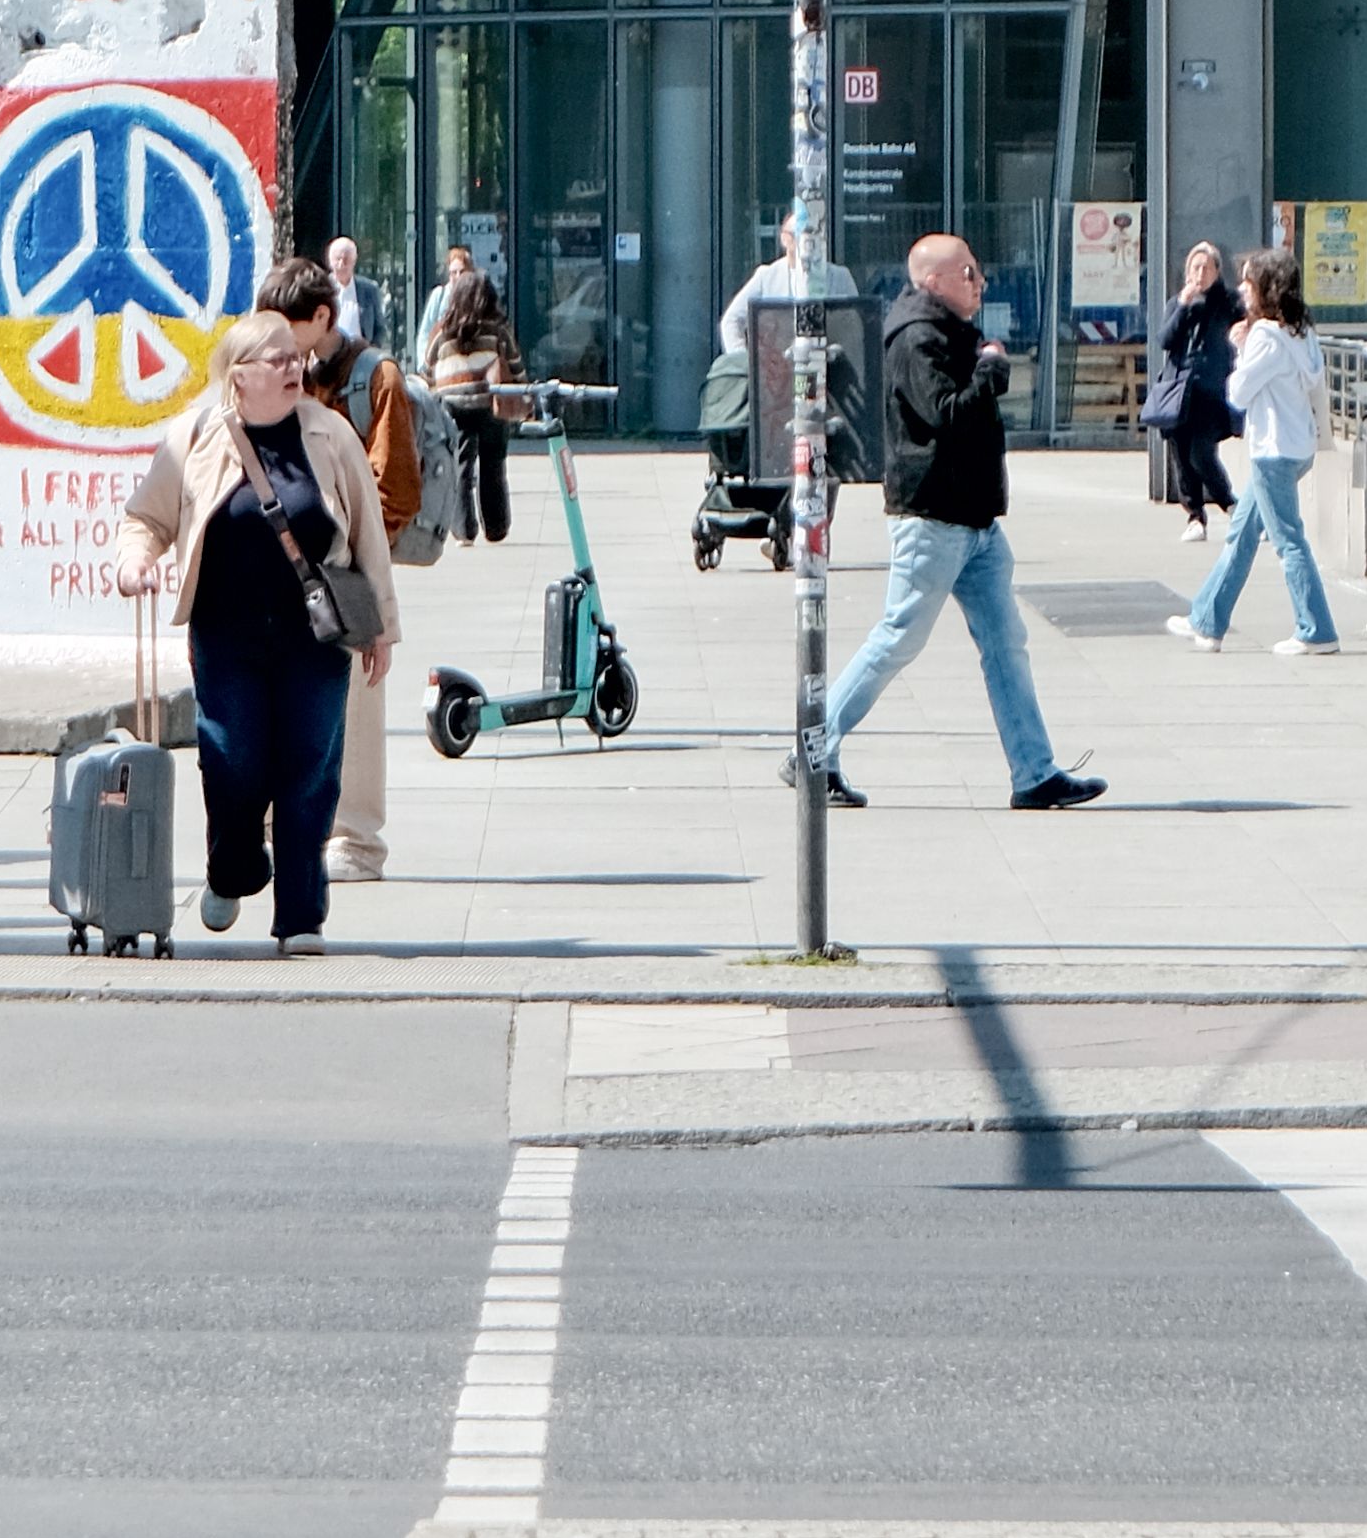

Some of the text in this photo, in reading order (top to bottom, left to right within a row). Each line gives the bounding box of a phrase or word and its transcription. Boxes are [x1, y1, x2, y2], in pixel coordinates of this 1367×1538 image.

[847, 75, 875, 99] DB
[843, 141, 917, 155] Deutsche Bahn AG
[20, 521, 63, 550] ALL
